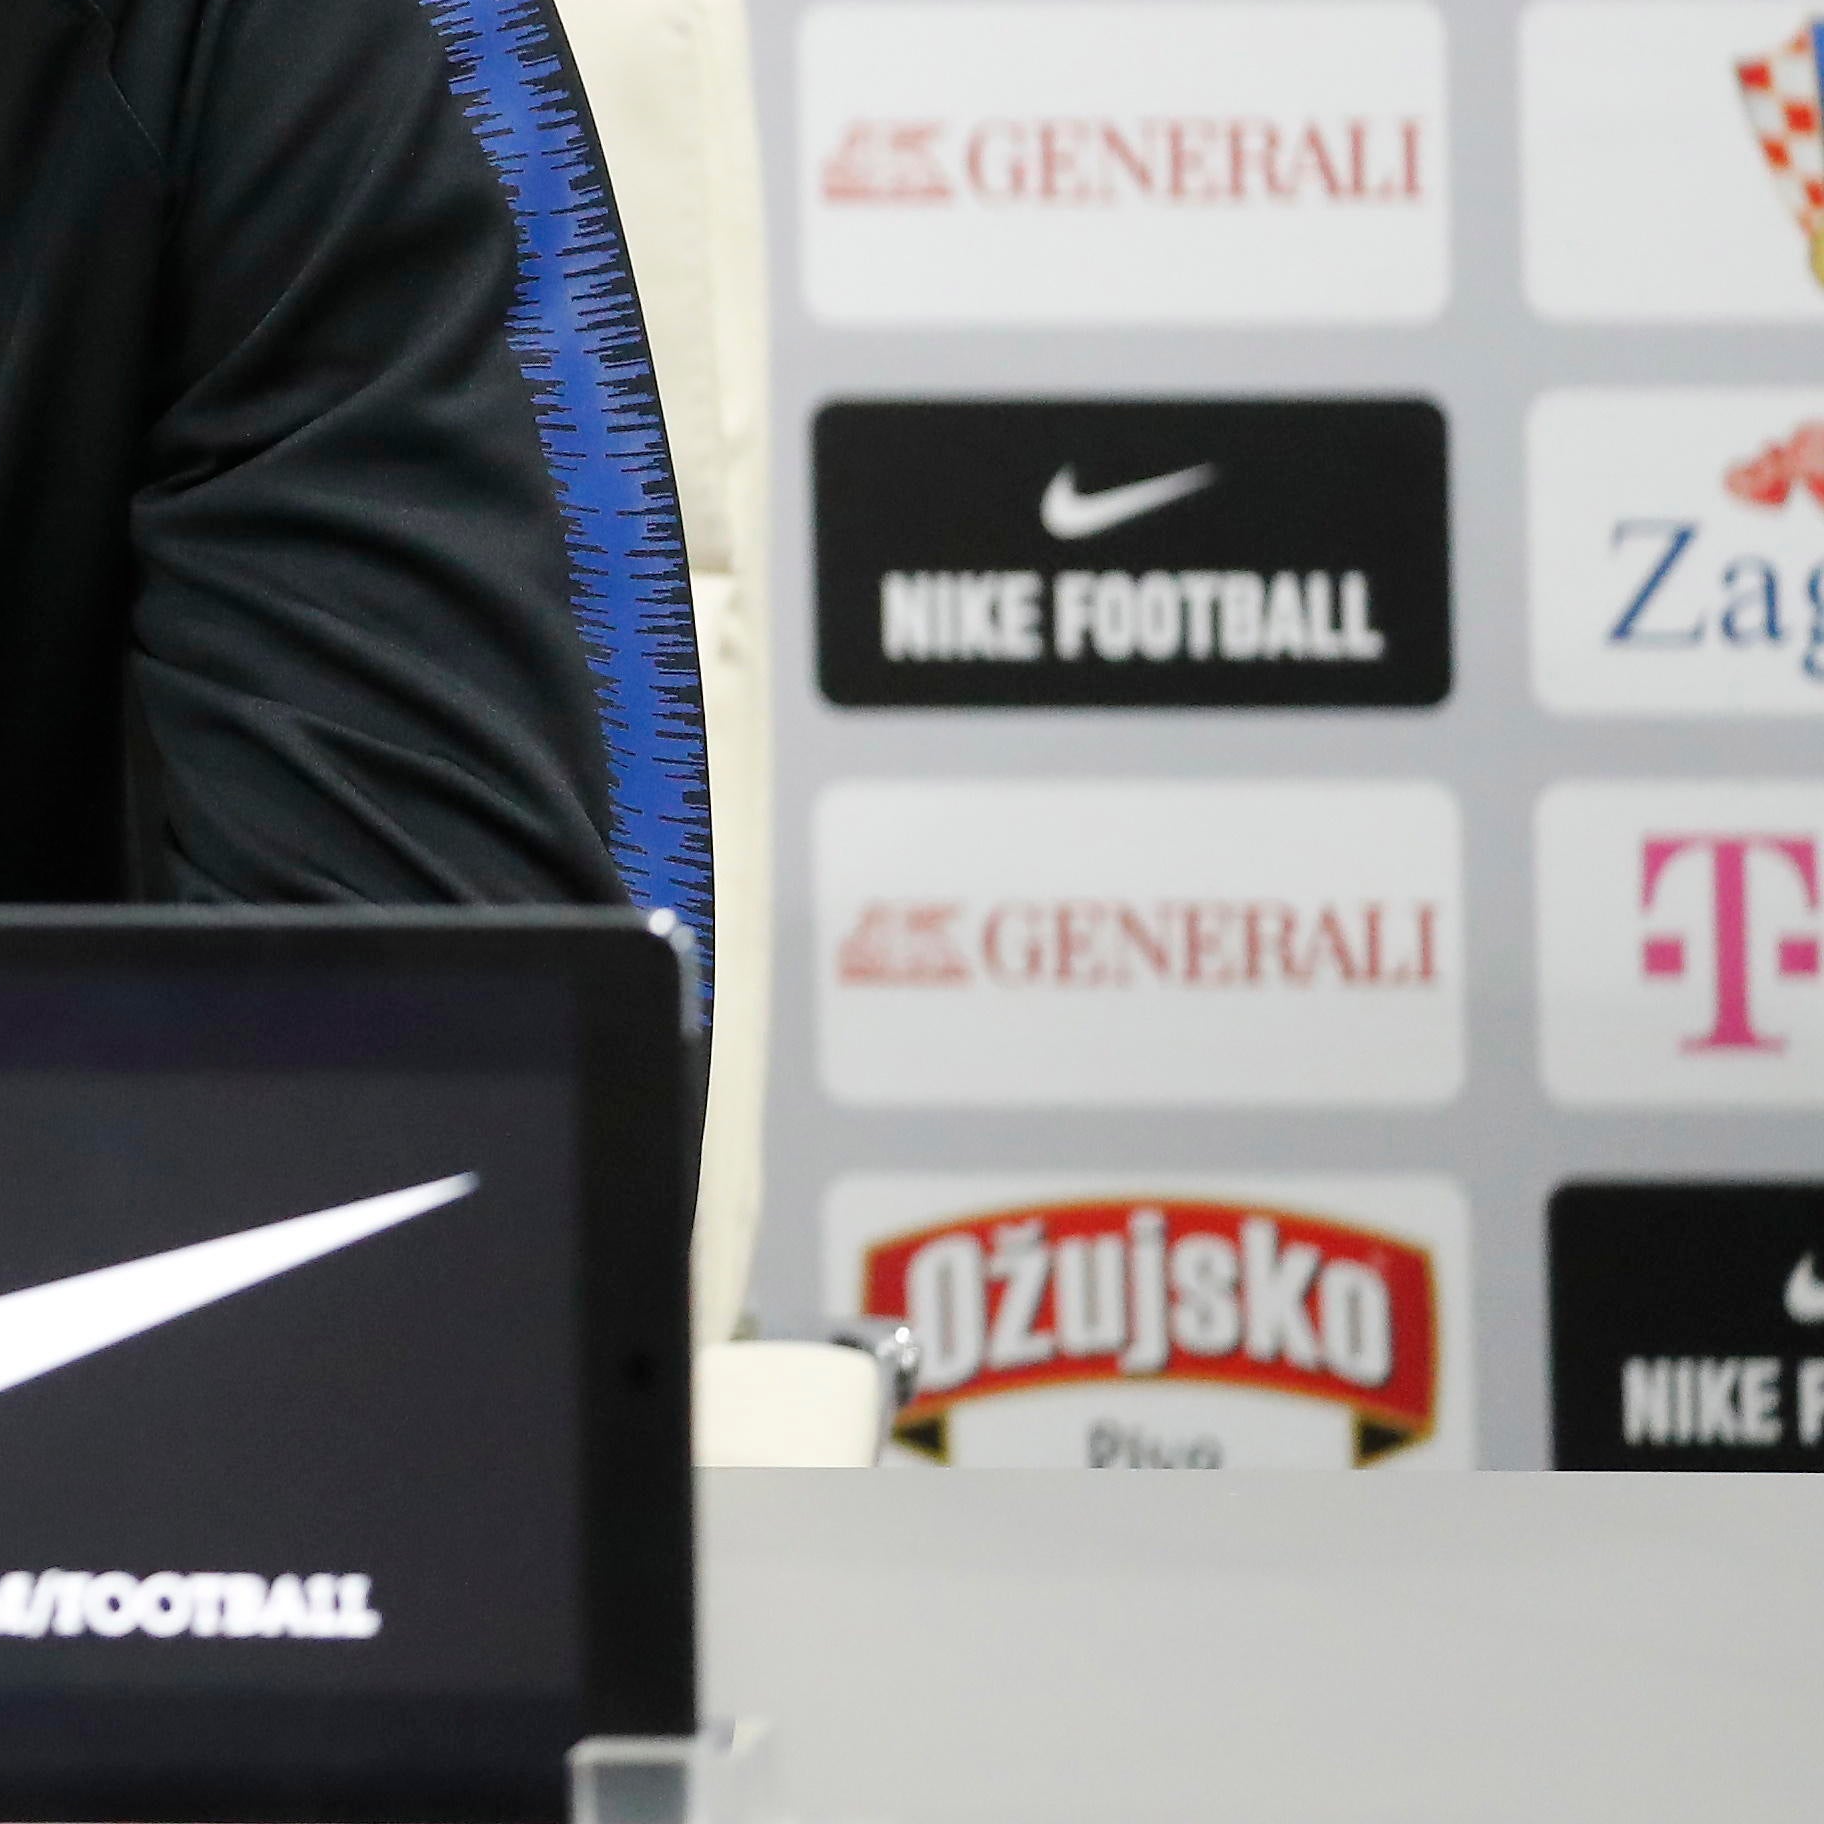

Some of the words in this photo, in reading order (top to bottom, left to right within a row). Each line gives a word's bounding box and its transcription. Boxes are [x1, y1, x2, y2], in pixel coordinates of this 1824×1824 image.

[962, 115, 1427, 207] GENERALI
[879, 567, 1044, 664] NIKE
[1052, 567, 1386, 664] FOOTBALL
[979, 899, 1440, 990] GENERALI
[908, 1208, 1391, 1391] Ožujsko
[1620, 1356, 1782, 1445] NIKE
